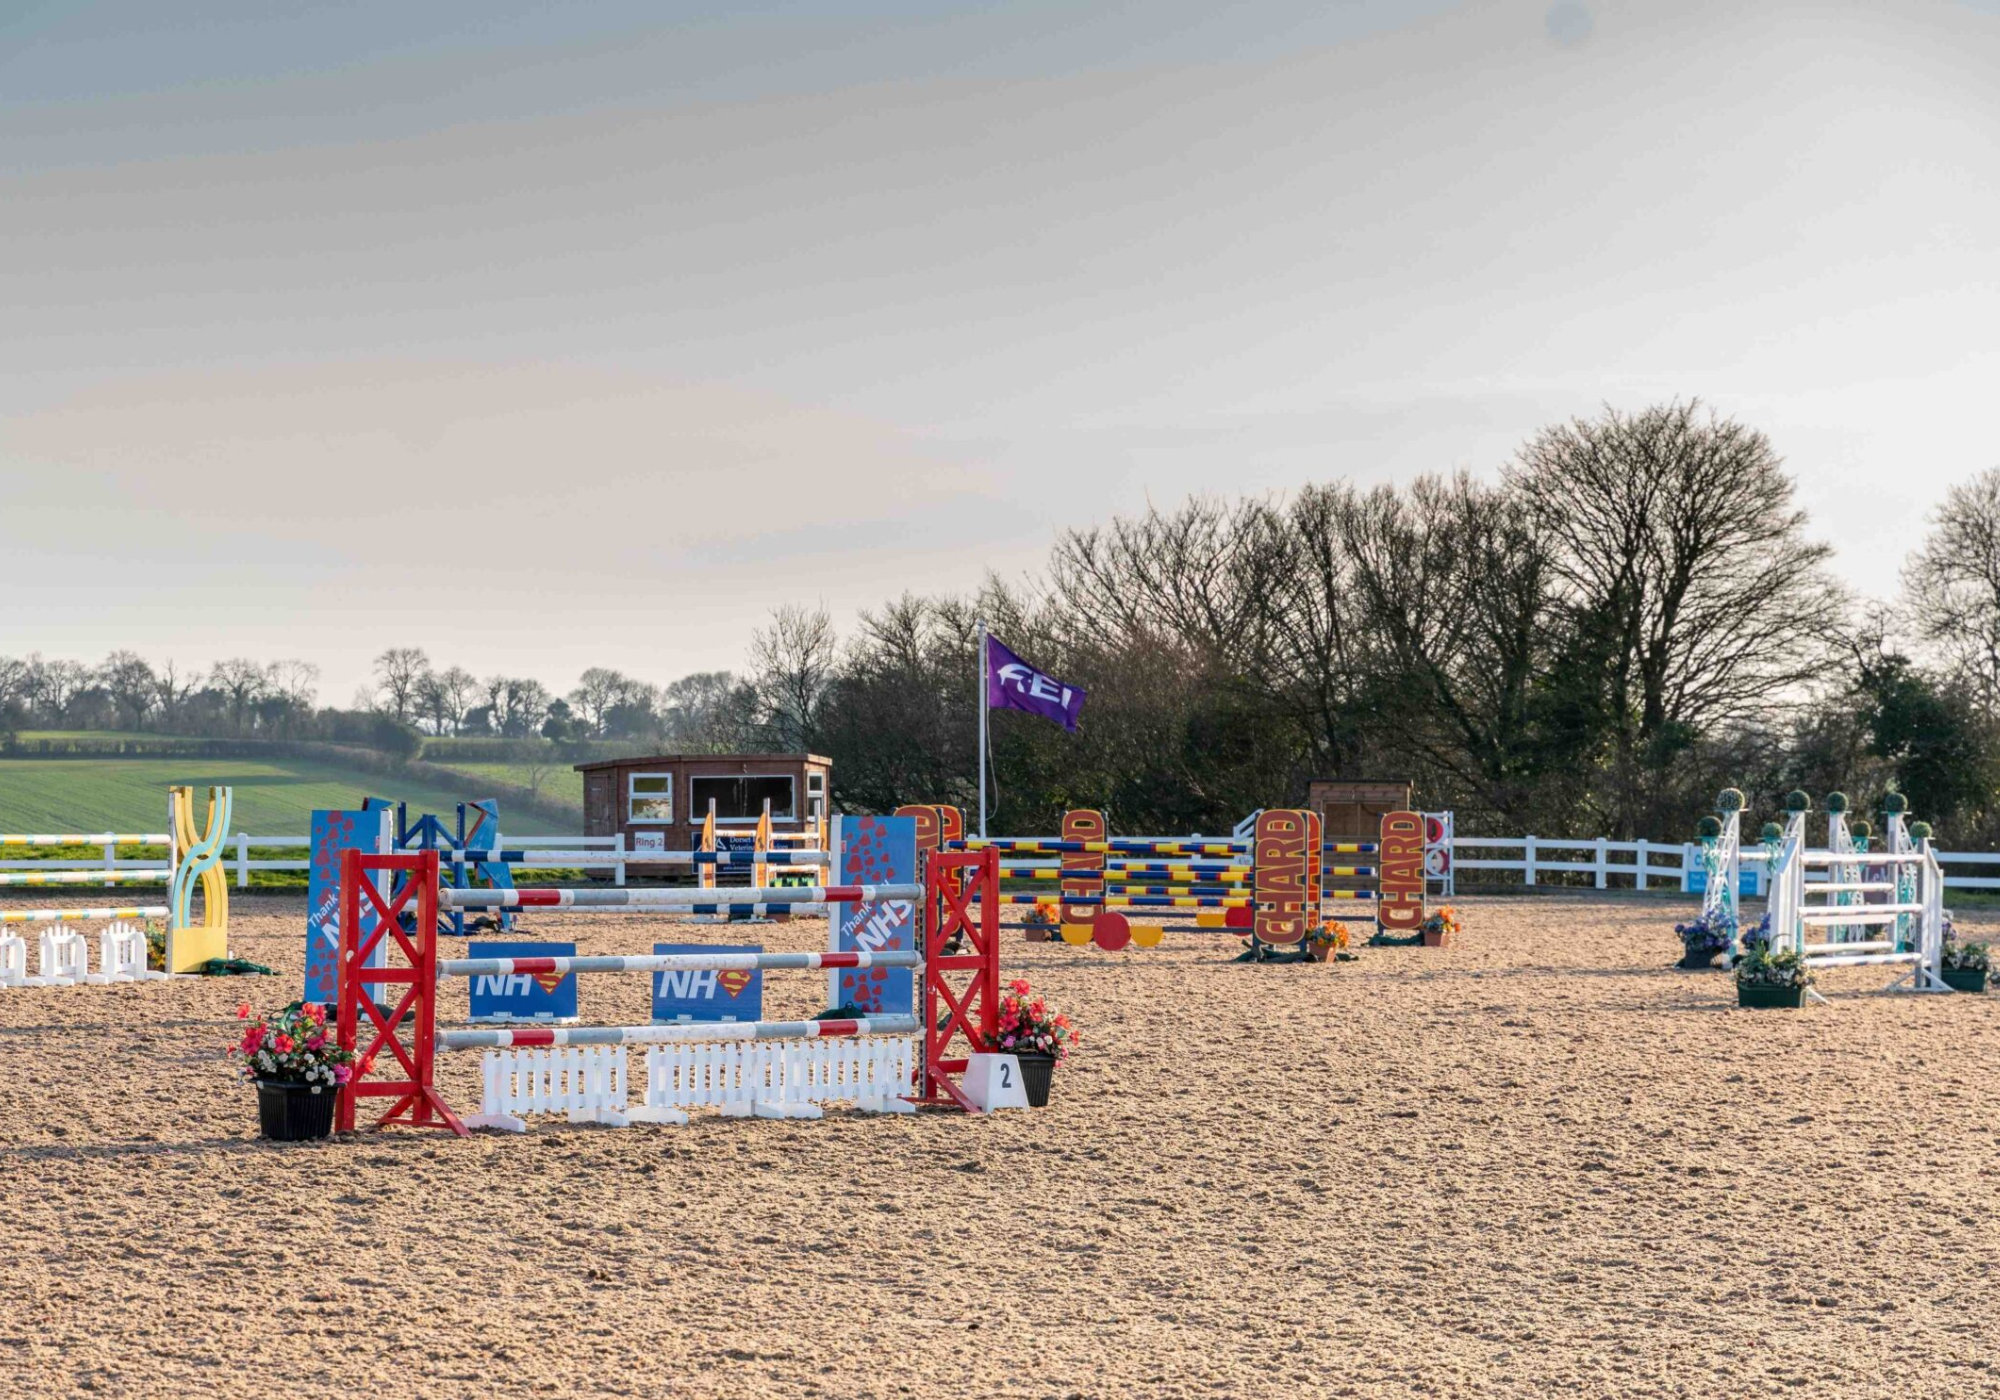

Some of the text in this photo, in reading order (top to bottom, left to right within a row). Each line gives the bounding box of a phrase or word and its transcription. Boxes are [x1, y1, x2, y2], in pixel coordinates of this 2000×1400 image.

[636, 837, 663, 848] Ring 2
[1254, 809, 1306, 945] CHARD
[1380, 811, 1424, 930] CHARD
[308, 894, 338, 928] Thank
[841, 902, 872, 937] Thank
[855, 899, 913, 953] NHS
[1000, 1063, 1012, 1088] 2
